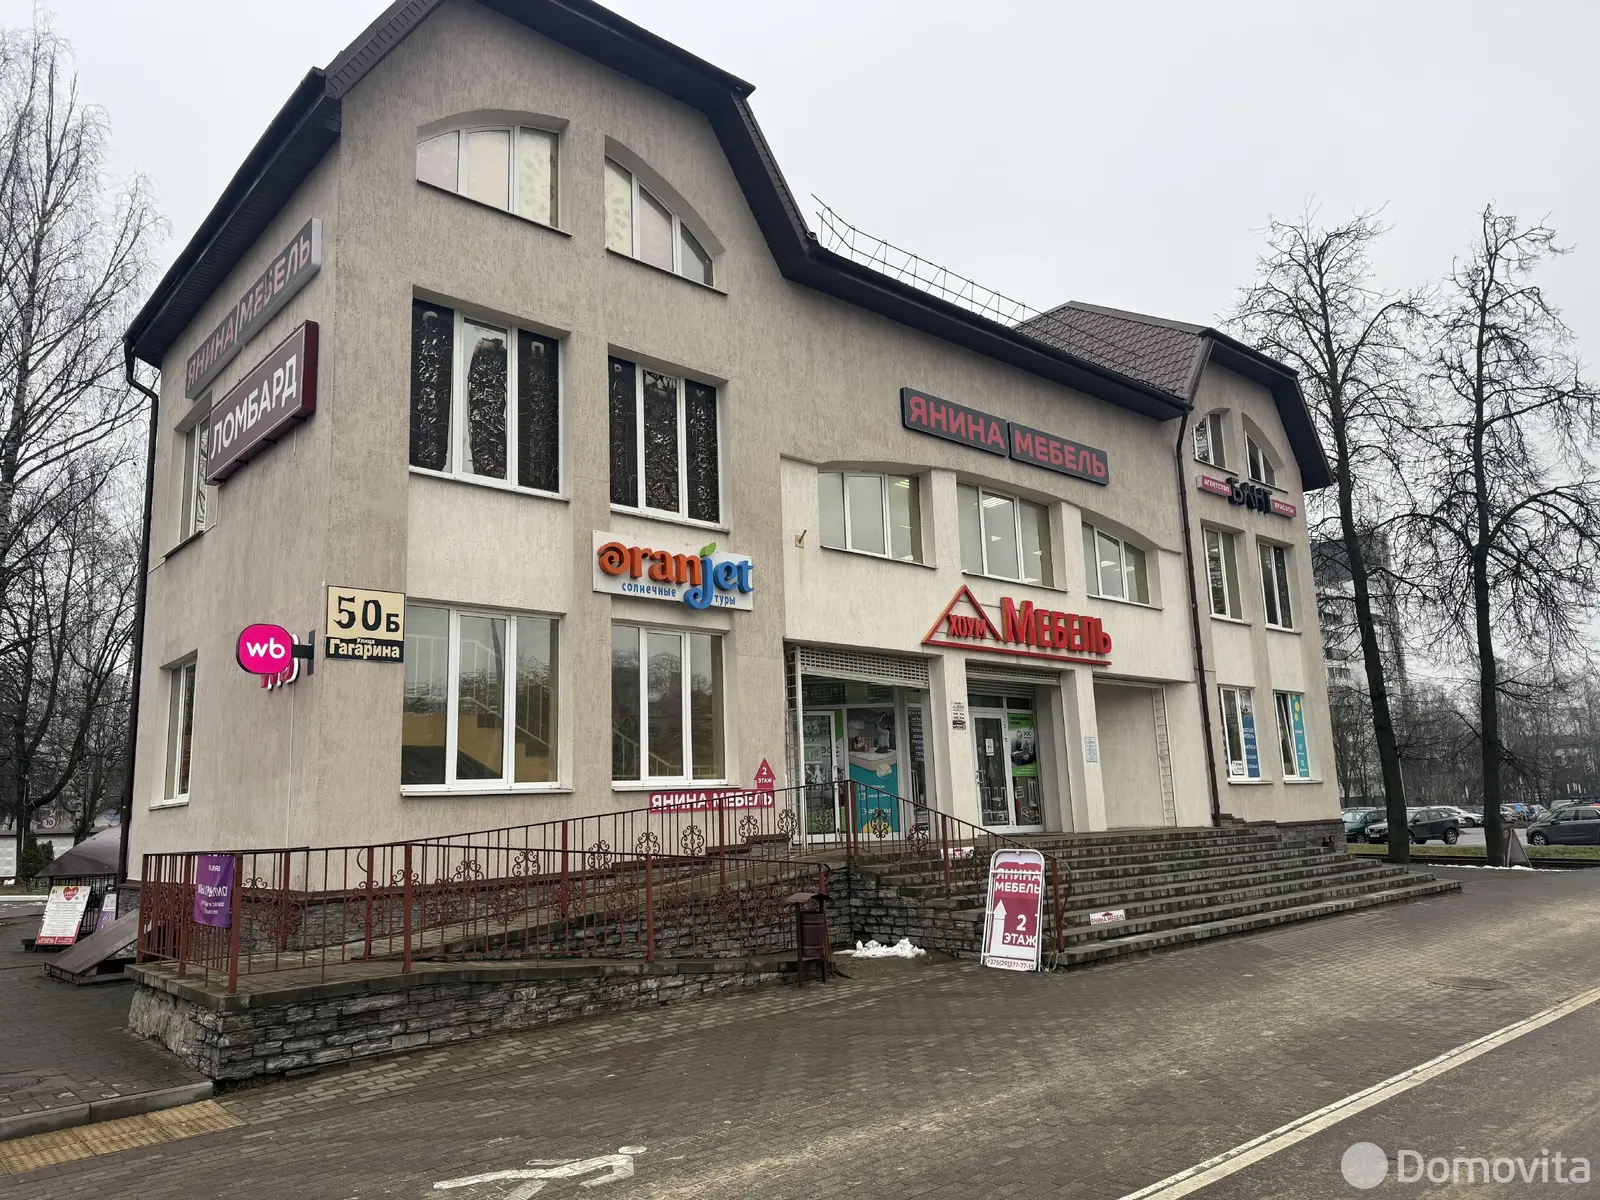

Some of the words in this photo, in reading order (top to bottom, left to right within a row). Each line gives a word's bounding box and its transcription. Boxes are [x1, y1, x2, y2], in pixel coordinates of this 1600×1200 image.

[186, 316, 235, 391] ЯНИНА
[239, 235, 311, 333] МЕБЕЛЬ
[210, 353, 297, 460] ЛОМБАРД
[909, 396, 1005, 449] ЯНИНА
[1014, 429, 1106, 478] МЕБЕЛЬ
[597, 541, 754, 609] oranjet
[621, 581, 677, 598] солнечные
[714, 593, 736, 606] туры
[947, 614, 987, 640] ХОУМ
[1000, 596, 1112, 655] МЕБЕЛЬ
[246, 637, 286, 659] wb
[329, 638, 400, 659] Гагарина
[356, 637, 376, 645] Улица
[762, 766, 768, 775] 2
[651, 793, 708, 811] ЯНИНА
[996, 868, 1041, 882] ЯНИНА
[995, 881, 1040, 894] МЕБЕЛЬ
[1016, 914, 1027, 931] 2
[1003, 932, 1036, 946] ЭТАЖ
